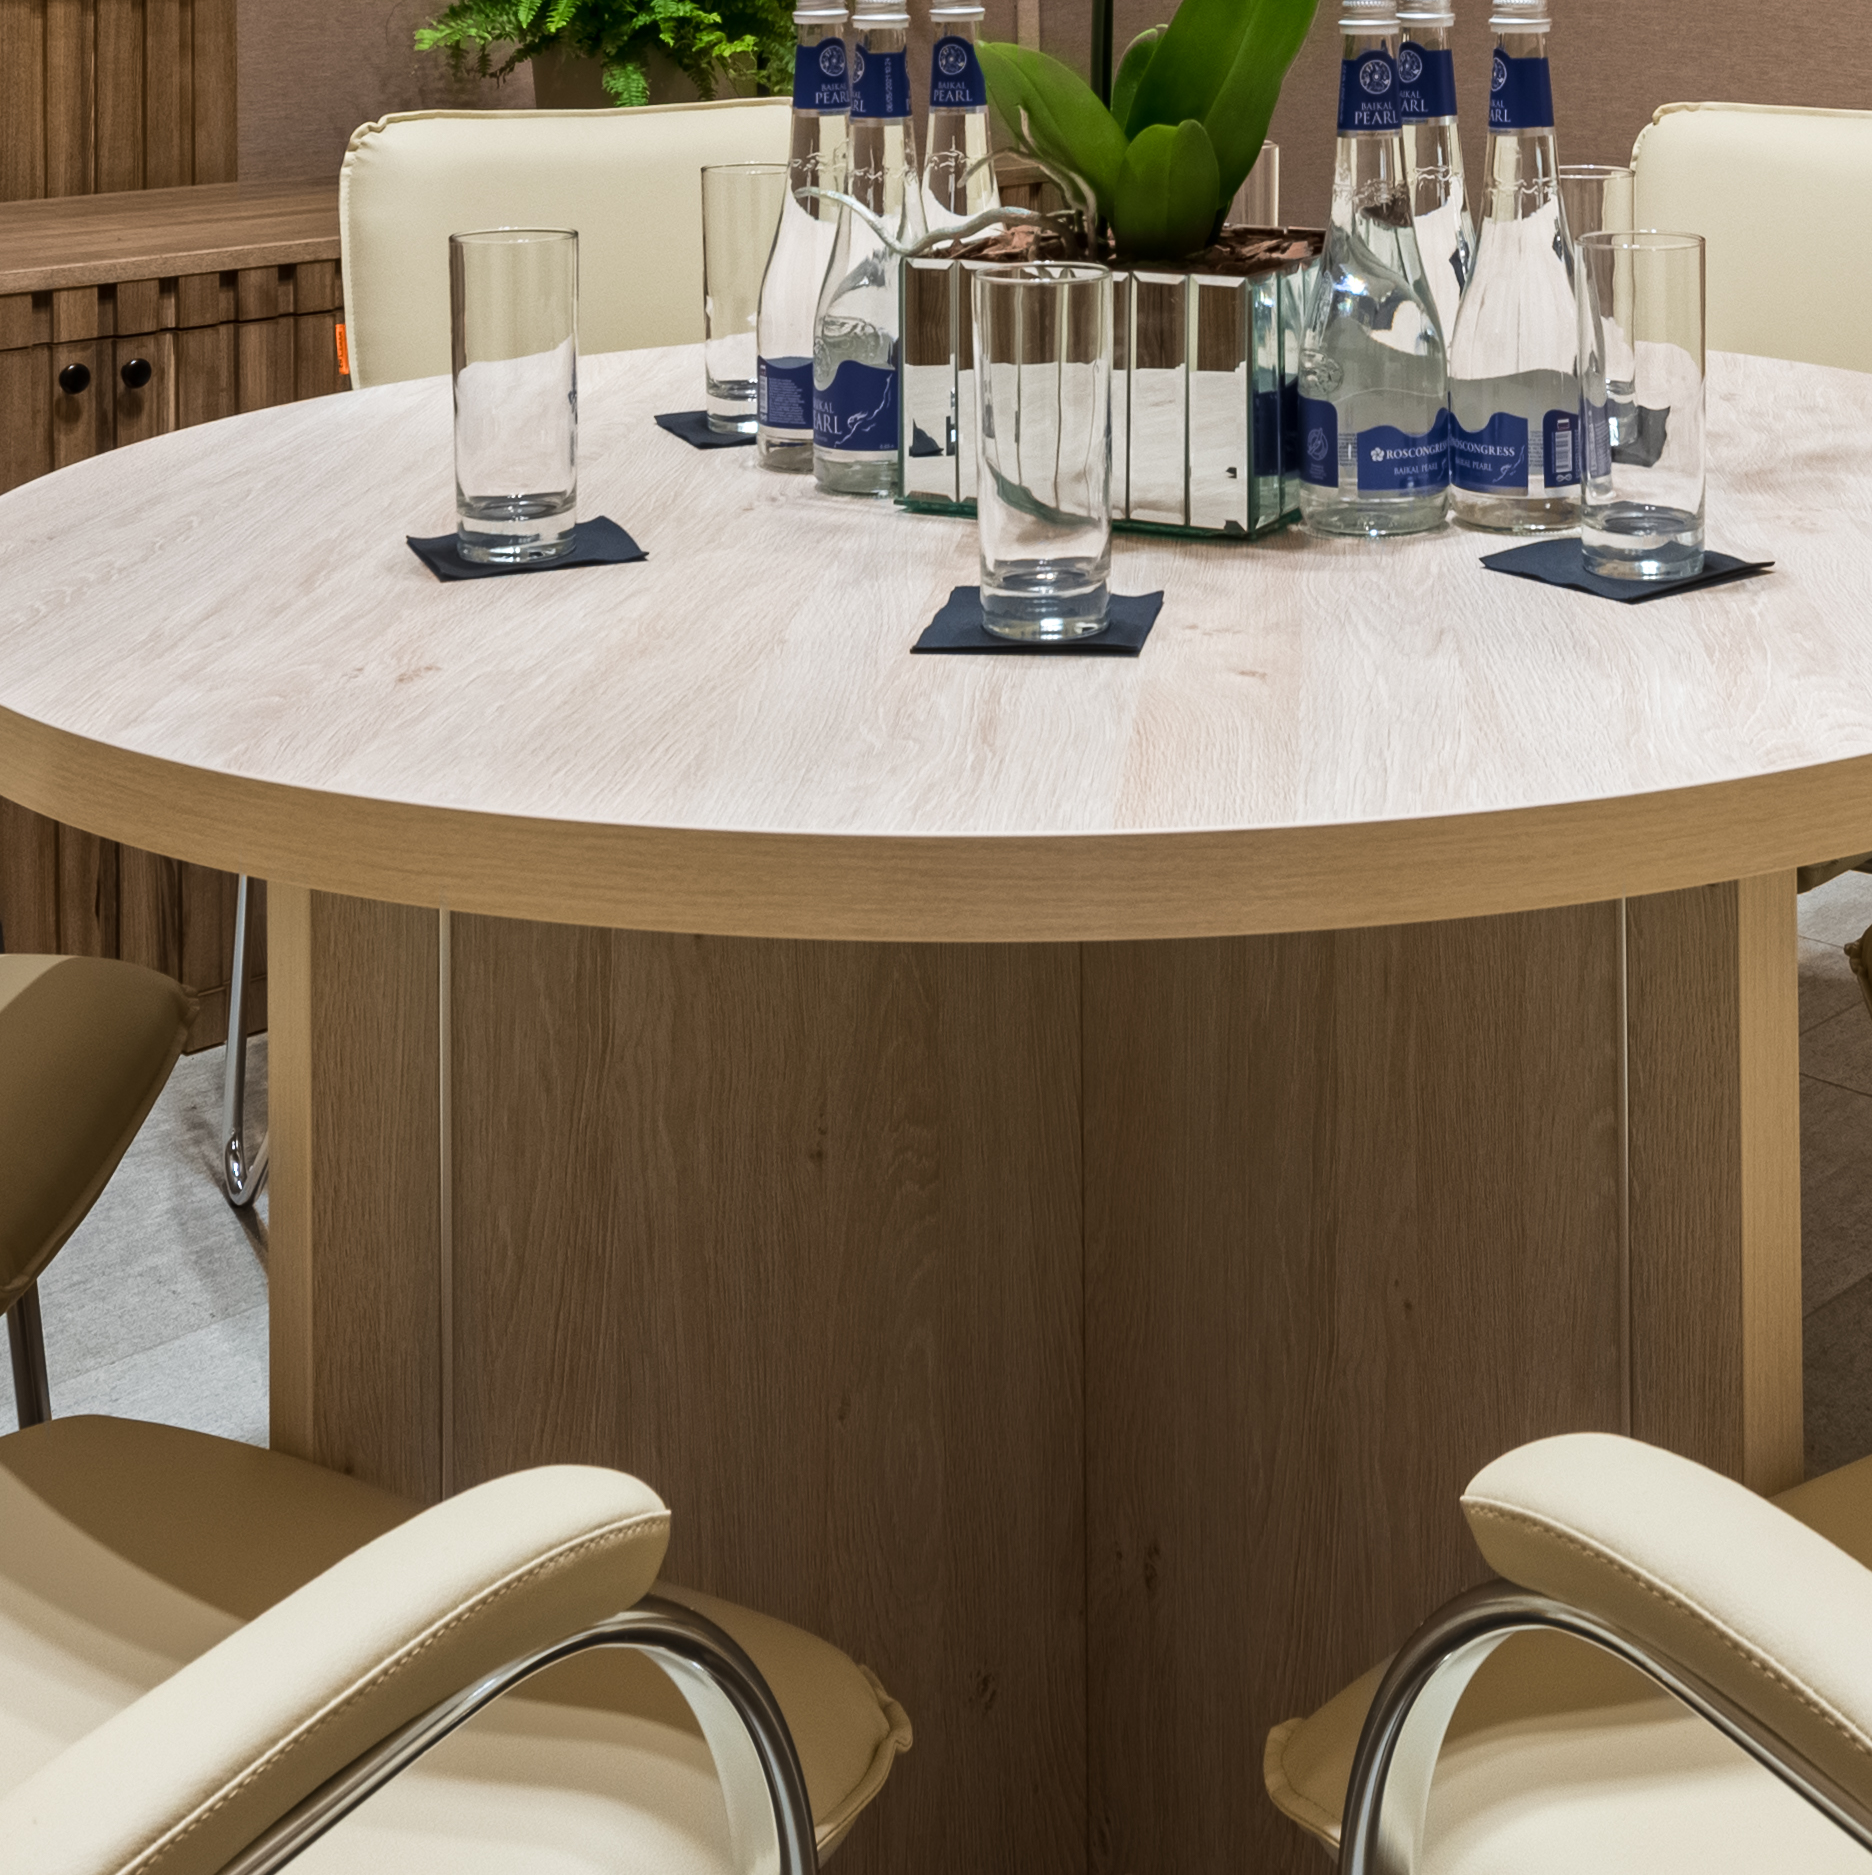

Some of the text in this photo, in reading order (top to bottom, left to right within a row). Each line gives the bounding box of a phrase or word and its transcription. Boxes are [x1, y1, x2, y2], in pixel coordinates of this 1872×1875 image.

[938, 81, 966, 90] BAIKAL
[933, 89, 974, 102] PEARL
[1361, 101, 1393, 111] BAIKAL
[1400, 99, 1430, 113] ARL
[1354, 110, 1399, 125] PEARL
[1489, 109, 1512, 123] ARL
[1394, 464, 1419, 475] BAIKAL
